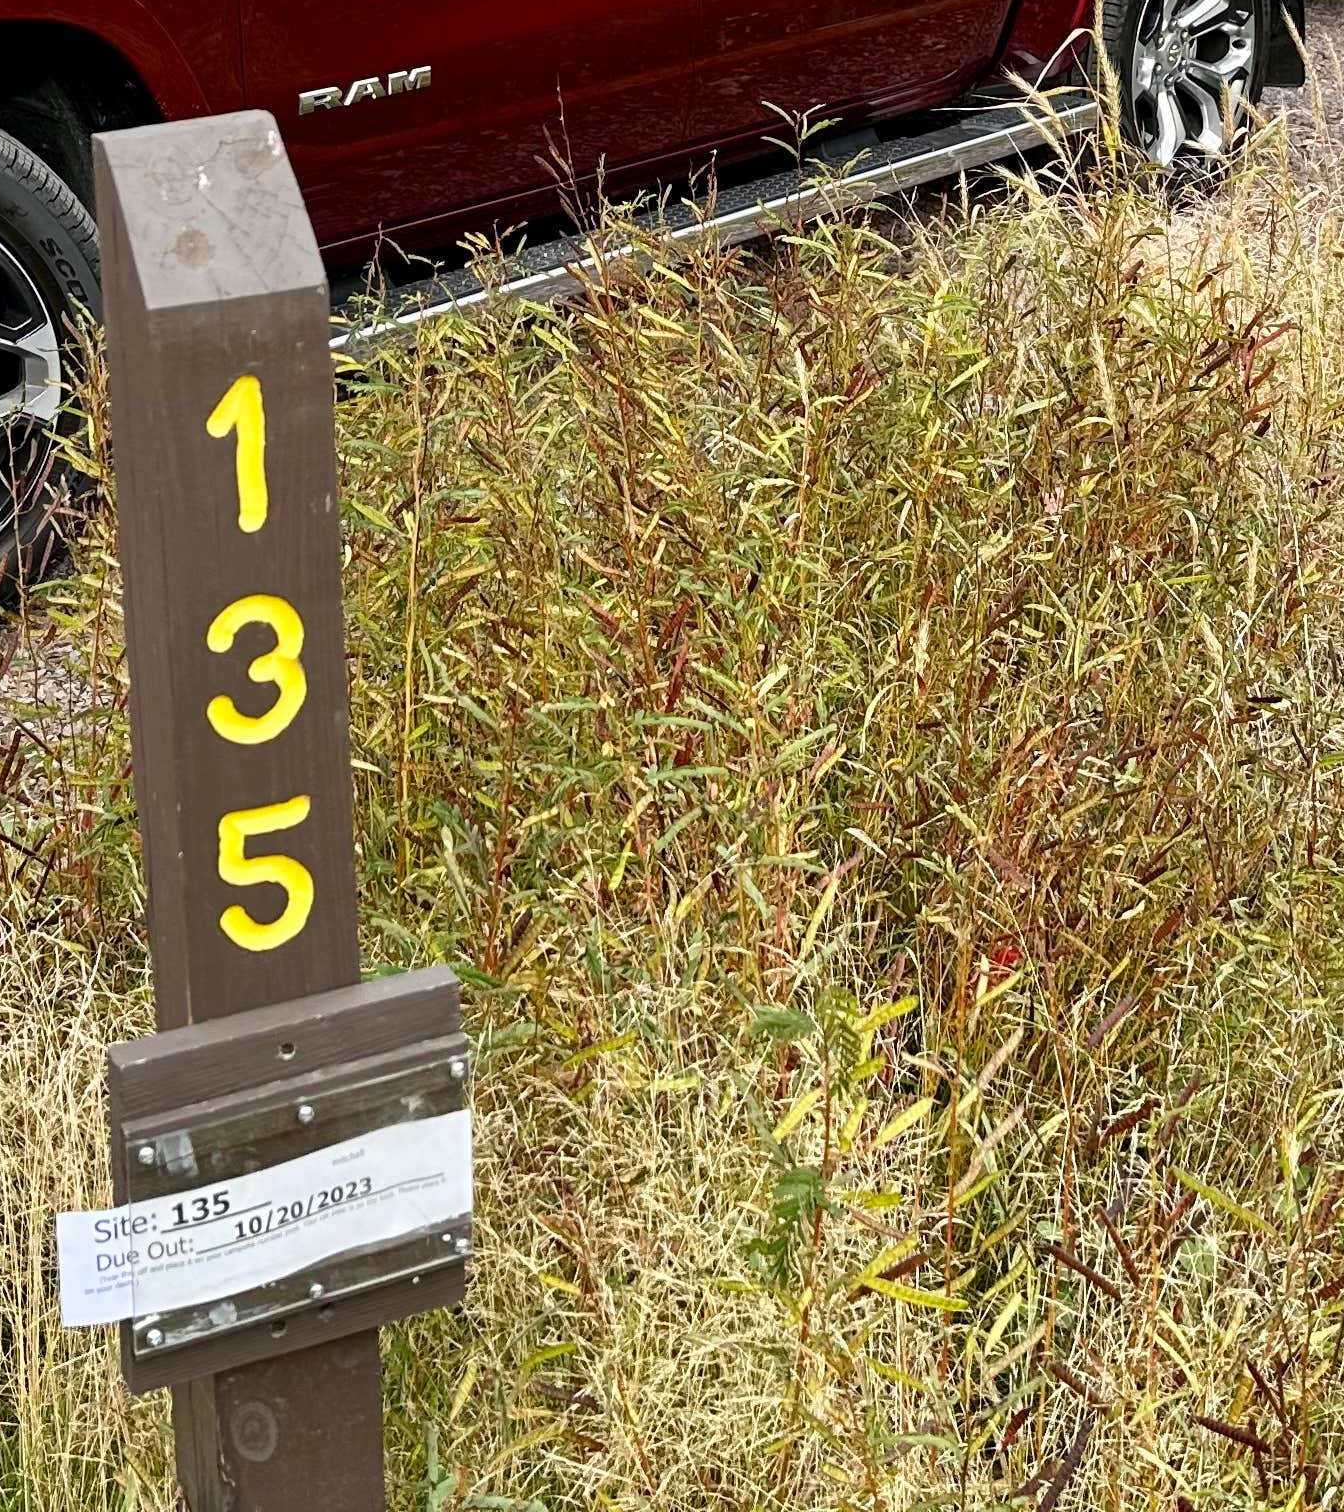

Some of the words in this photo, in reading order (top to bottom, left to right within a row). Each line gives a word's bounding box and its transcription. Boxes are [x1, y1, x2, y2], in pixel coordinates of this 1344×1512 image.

[299, 65, 432, 115] RAM
[94, 1212, 157, 1244] Site:
[172, 1190, 230, 1226] 135
[96, 1249, 139, 1272] Due
[147, 1237, 194, 1260] Out:
[234, 1176, 372, 1240] 10/20/2023
